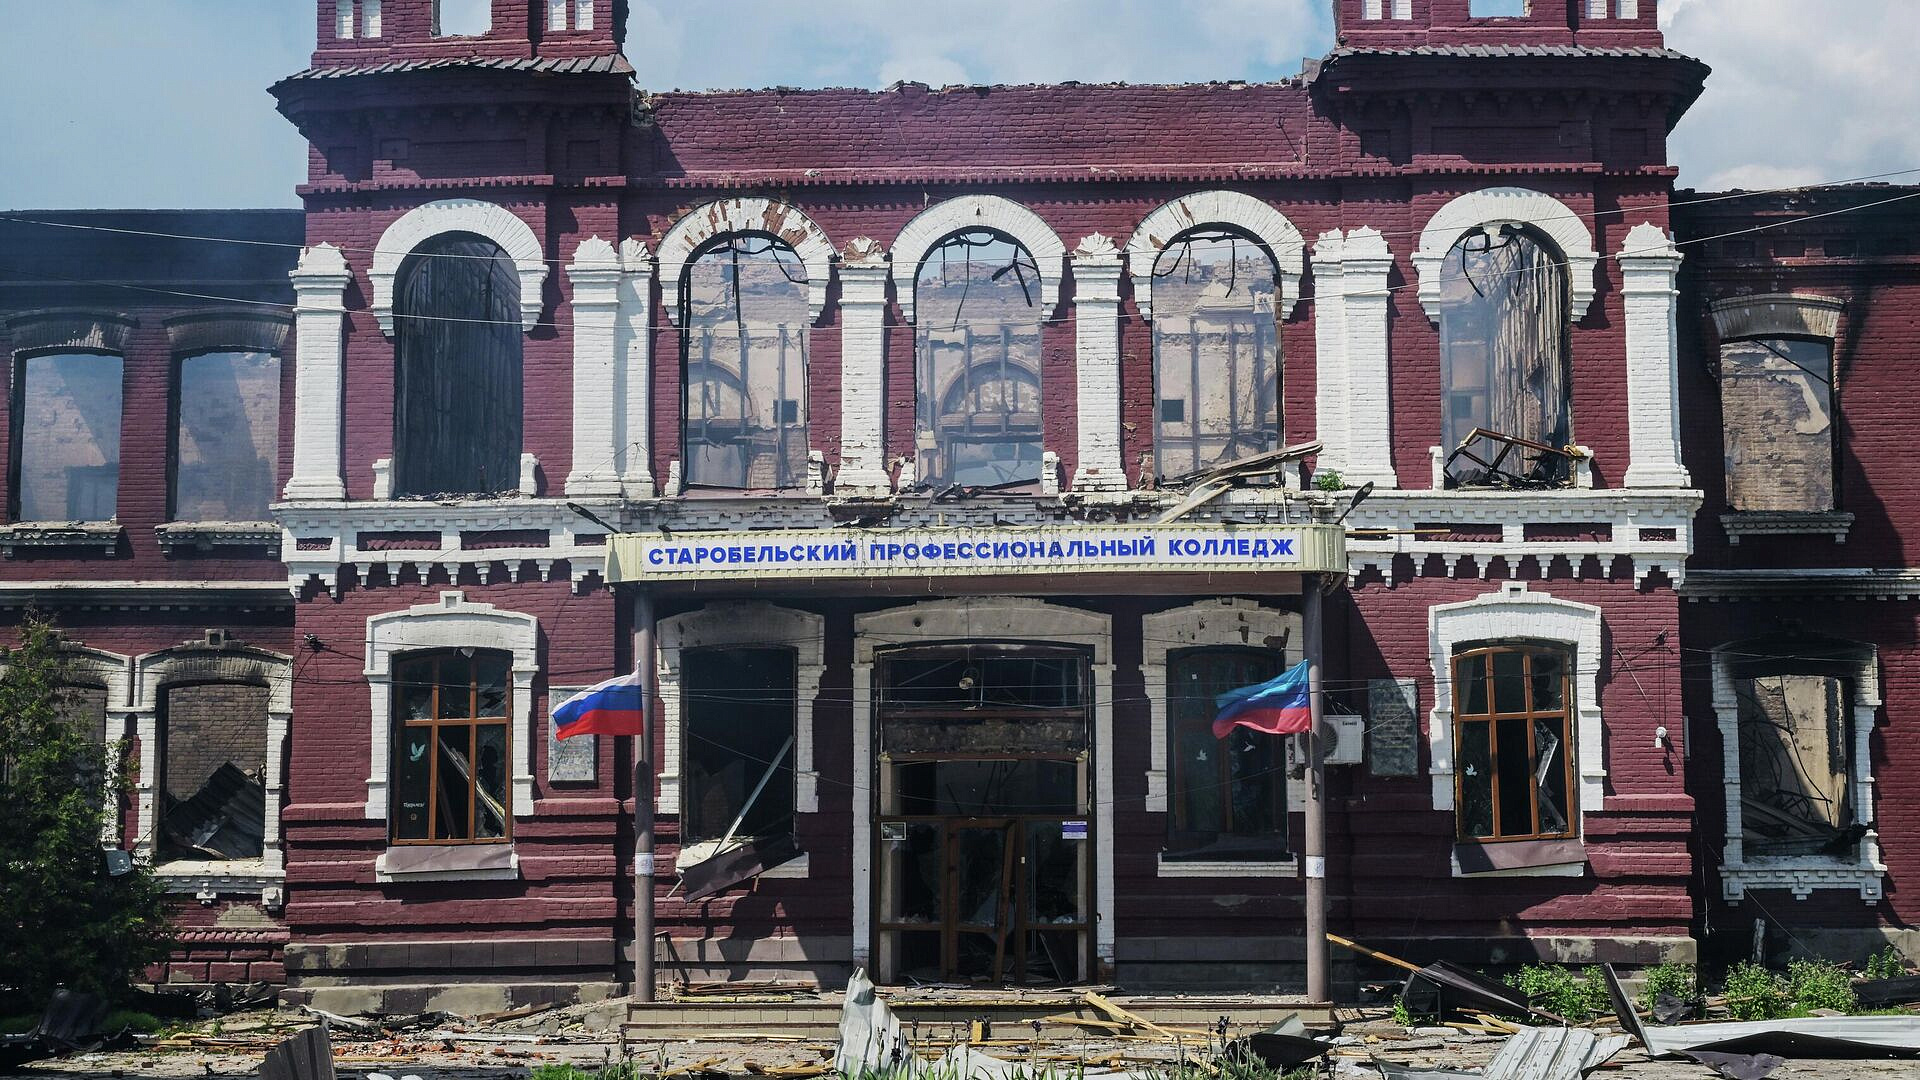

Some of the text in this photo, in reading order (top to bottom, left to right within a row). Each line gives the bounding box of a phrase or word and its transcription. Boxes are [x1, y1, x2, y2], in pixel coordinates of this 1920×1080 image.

[649, 536, 1293, 565] СТАРОБЕЛЬСКИЙ ПРОФЕССИОНАЛЬНЫЙ КОЛЛЕДЖ
